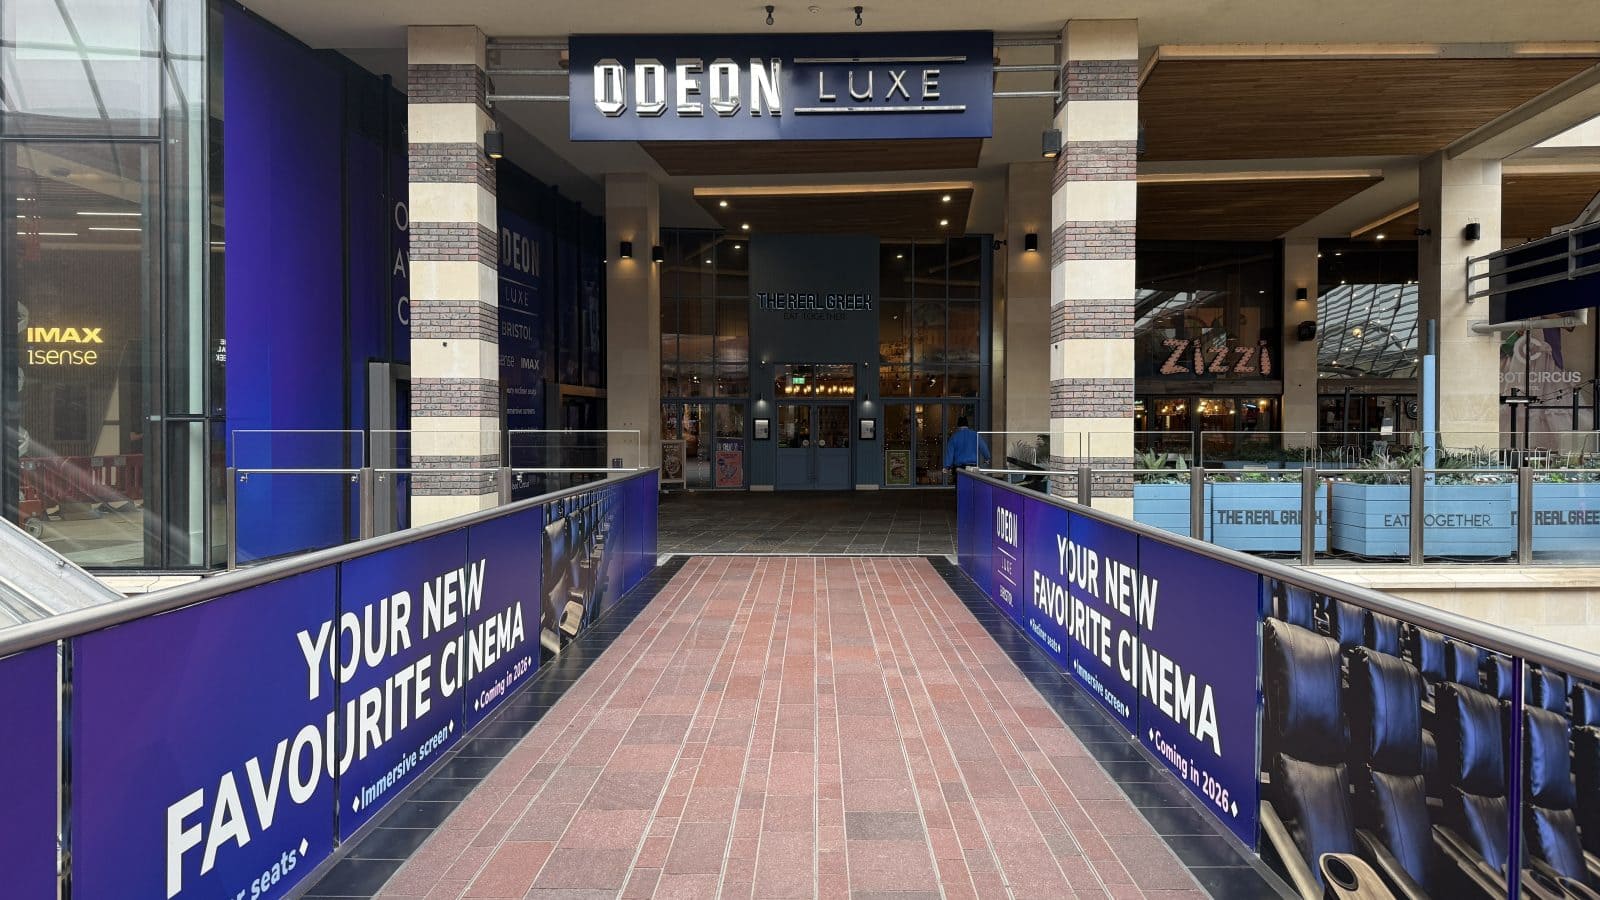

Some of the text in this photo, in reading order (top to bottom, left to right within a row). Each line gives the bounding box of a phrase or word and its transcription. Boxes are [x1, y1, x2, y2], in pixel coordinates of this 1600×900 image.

[593, 57, 941, 118] ODEON LUXE
[498, 226, 540, 278] DEON
[756, 292, 872, 311] THE REAL GREEK
[27, 327, 104, 344] IMAX
[27, 347, 98, 366] isense
[1159, 337, 1272, 376] Zizzi
[1529, 371, 1582, 383] CIRCUS
[996, 506, 1018, 548] ODEON
[1217, 510, 1323, 525] THE REAL GRK
[1384, 514, 1493, 527] EAT OGETHER.
[1535, 510, 1567, 525] REAL
[1568, 511, 1600, 525] GREE
[1057, 534, 1159, 631] YOUR NEW
[296, 558, 487, 701] YOUR NEW
[480, 656, 528, 709] Coming in 2026
[1032, 569, 1222, 757] FAVOURITE CINEMA
[1076, 659, 1126, 717] Immersive screen
[166, 601, 525, 900] FAVOURITE CINEMA
[361, 725, 448, 811] Immersive screen
[1155, 730, 1230, 813] Coming in 2026
[250, 848, 297, 900] seats
